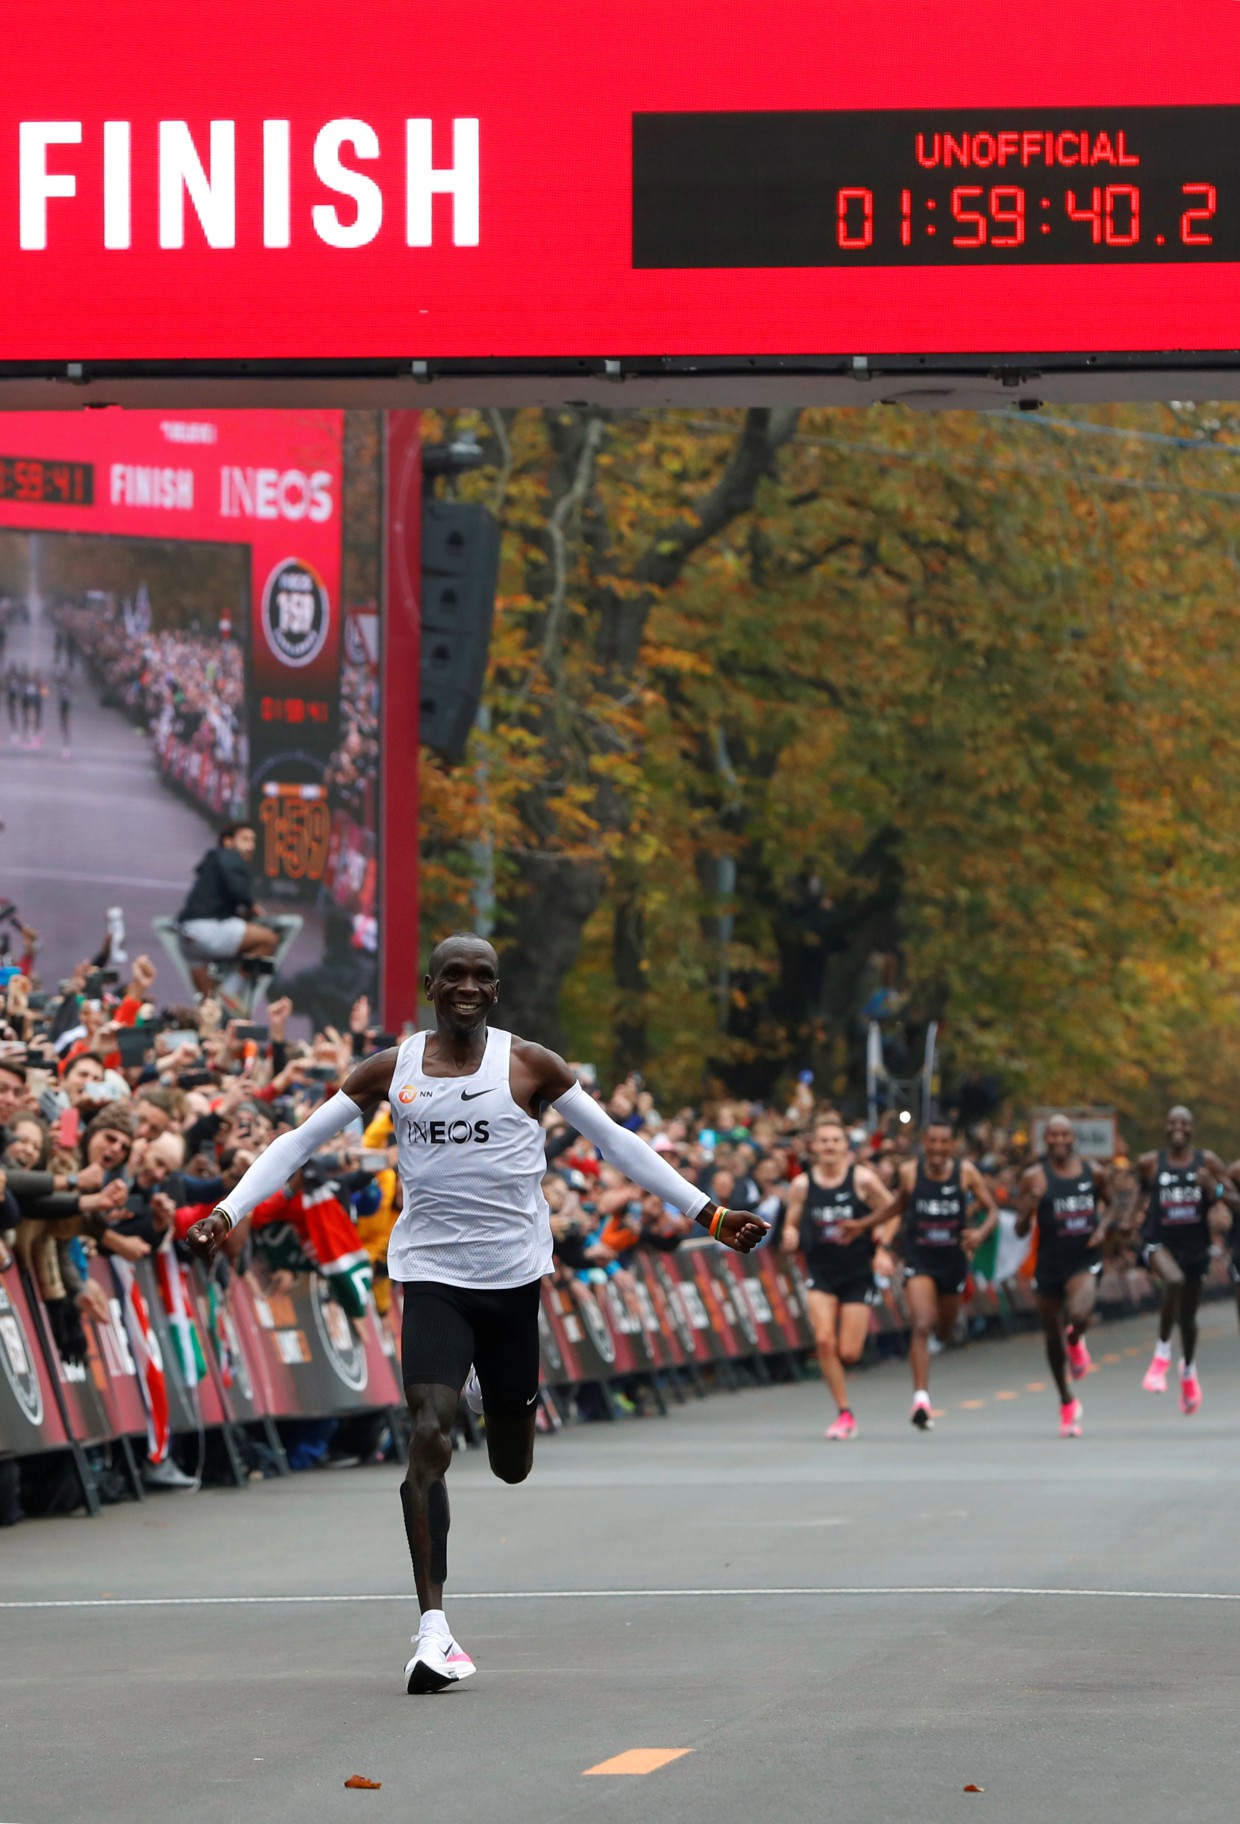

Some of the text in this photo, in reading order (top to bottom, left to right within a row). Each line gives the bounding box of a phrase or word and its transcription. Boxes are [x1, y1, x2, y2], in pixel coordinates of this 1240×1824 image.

[916, 130, 1140, 168] UNOFFICIAL
[19, 117, 480, 250] FINISH
[111, 463, 194, 509] FINISH
[220, 466, 333, 522] INEOS
[407, 1120, 490, 1144] INEOS
